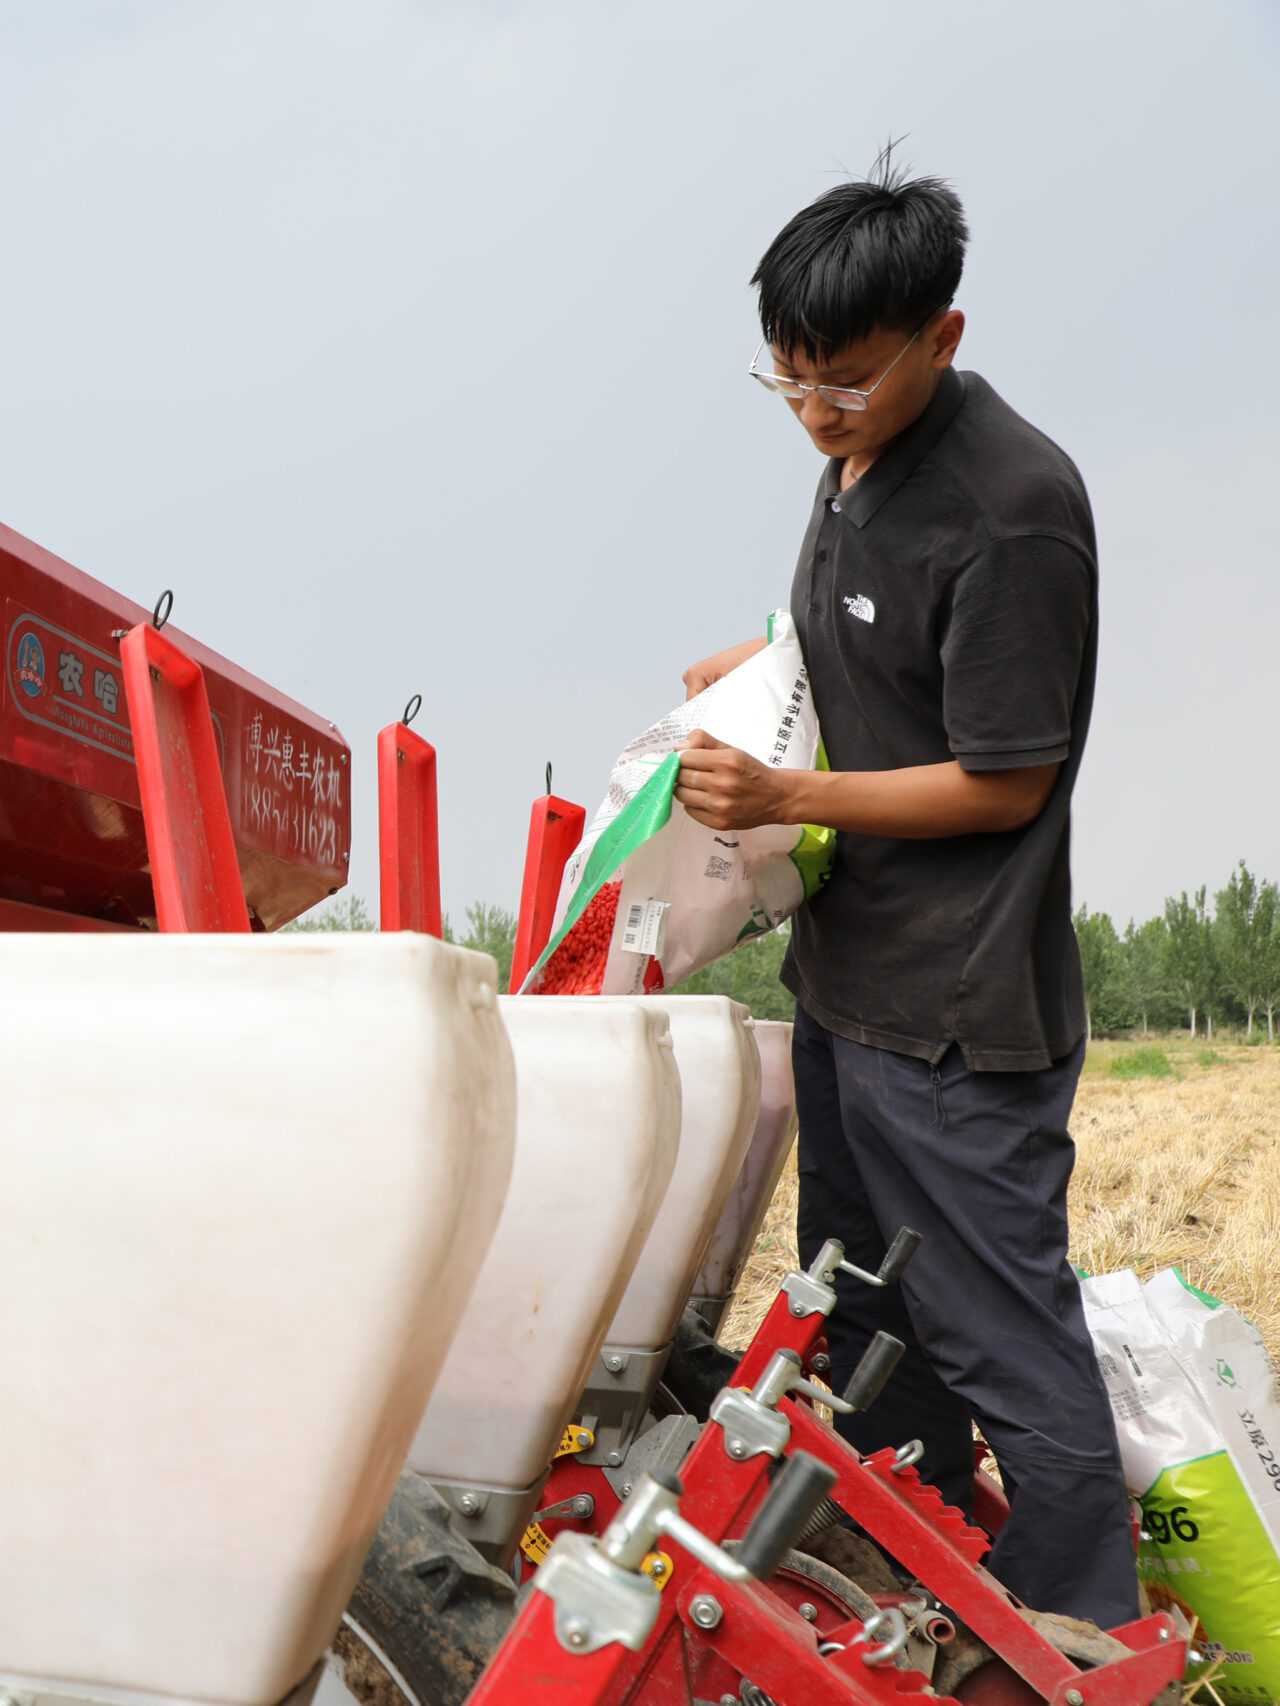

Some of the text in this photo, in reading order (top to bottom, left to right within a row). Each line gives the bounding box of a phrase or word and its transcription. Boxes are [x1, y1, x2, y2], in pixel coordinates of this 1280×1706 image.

[58, 651, 118, 715] 农哈
[244, 709, 341, 808] 博兴惠丰农机
[1143, 1506, 1199, 1544] 96
